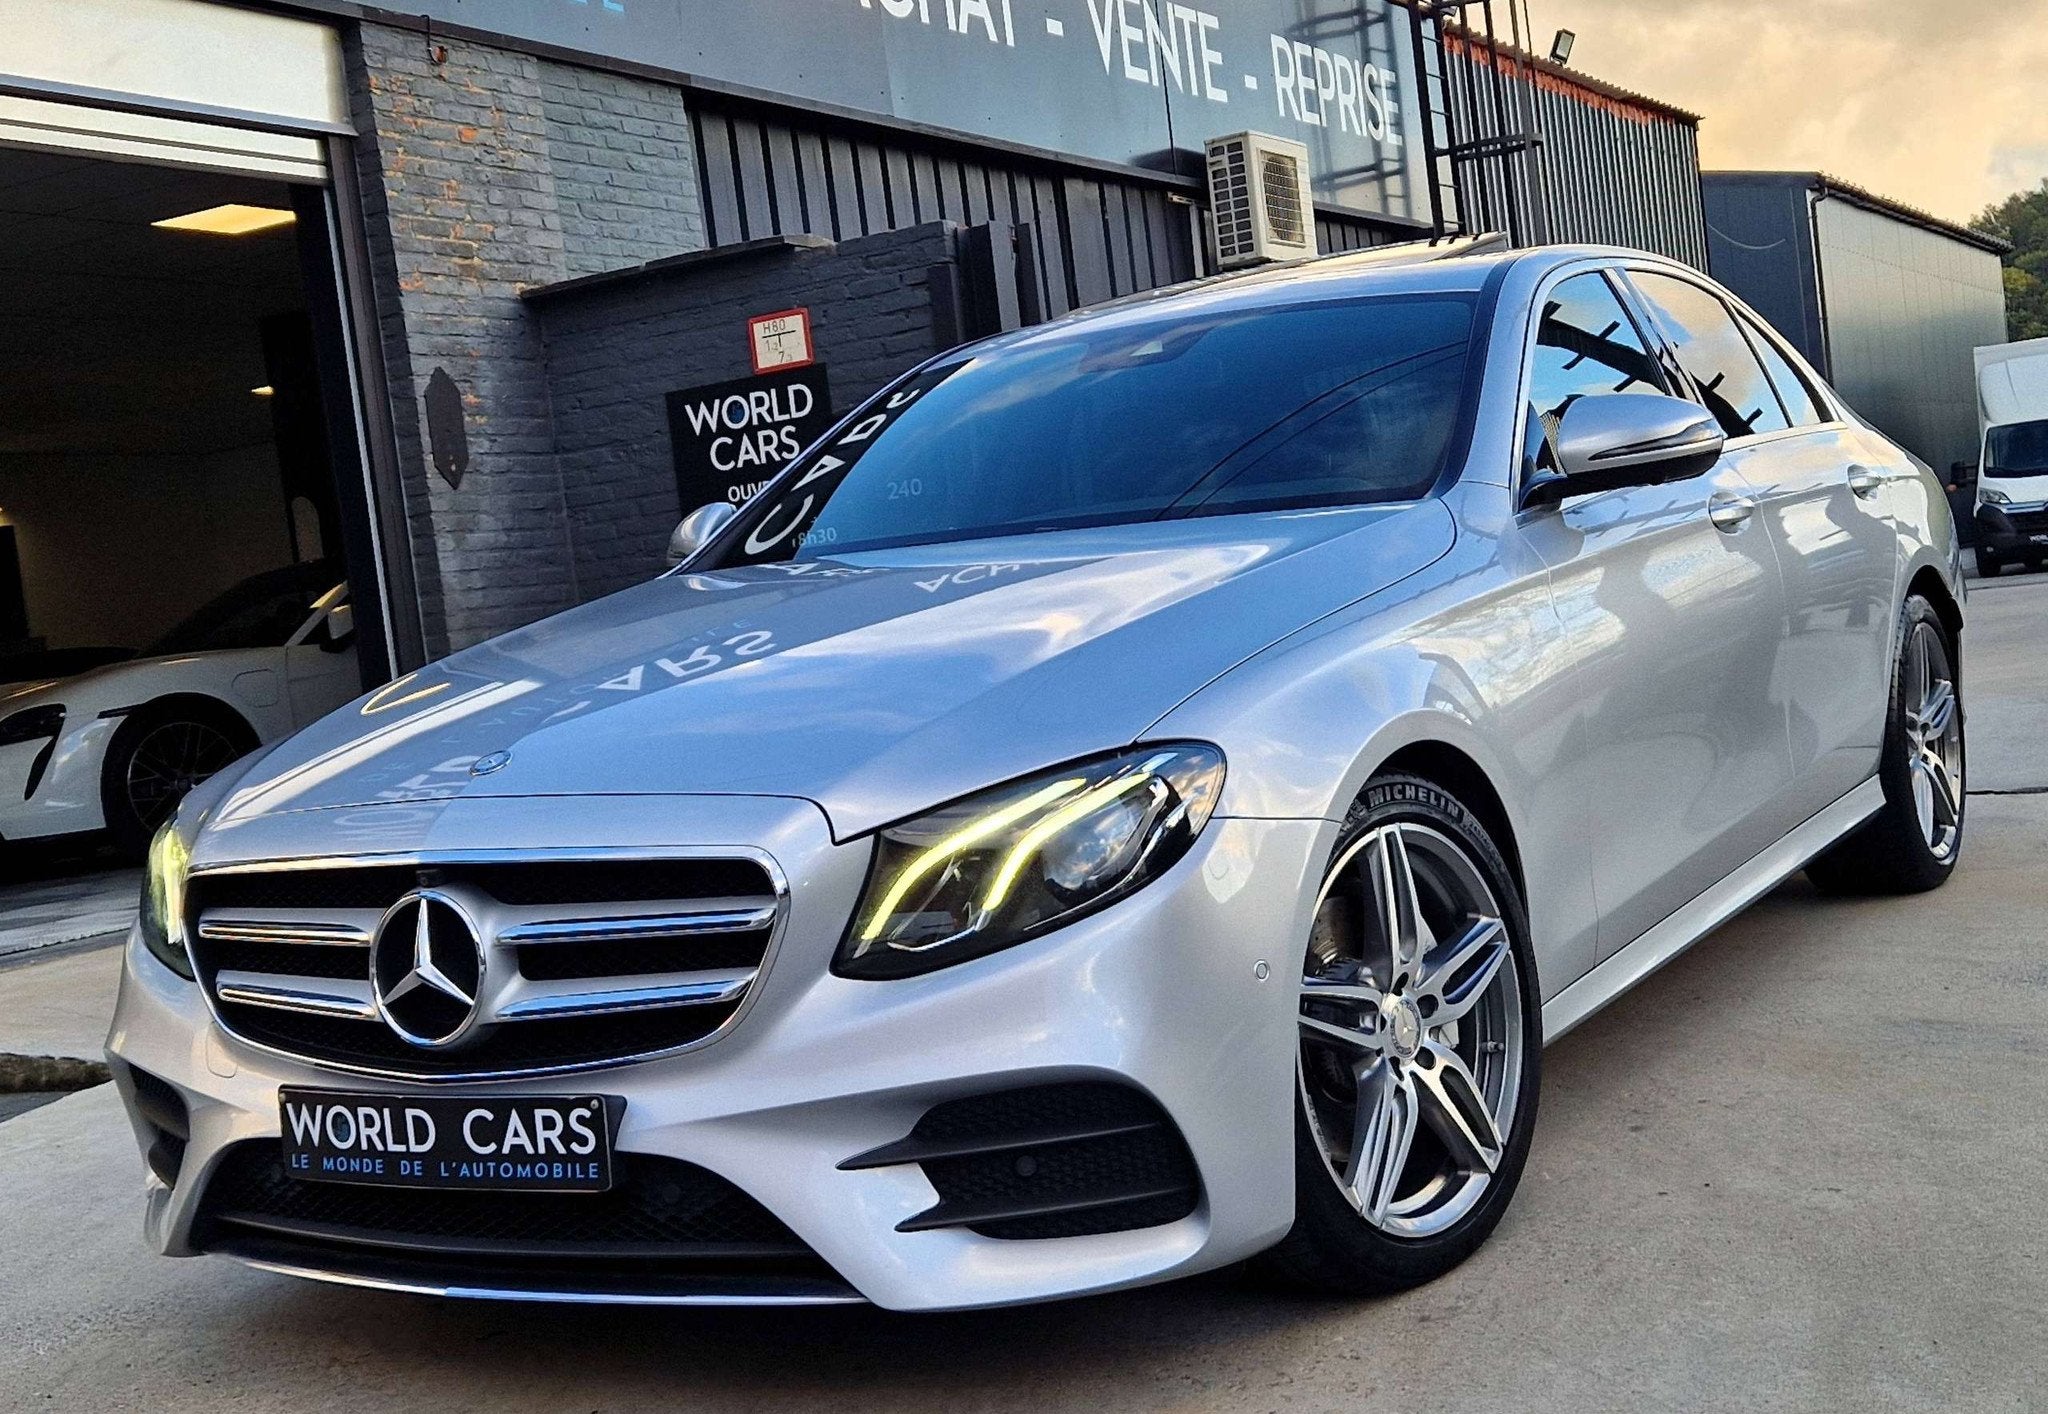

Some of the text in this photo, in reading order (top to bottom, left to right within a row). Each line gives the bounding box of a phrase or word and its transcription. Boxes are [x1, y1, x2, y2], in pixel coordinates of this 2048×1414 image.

[1087, 0, 1228, 103] VENTE
[1270, 33, 1403, 146] REPRISE
[762, 318, 787, 334] H80
[684, 383, 813, 436] WORLD
[709, 425, 800, 471] CARS
[727, 480, 772, 502] OUV
[1367, 783, 1460, 819] MICHELIN
[285, 1102, 597, 1155] WORLD CARS
[291, 1153, 599, 1179] LE MONDE DE L'AUTOMOBILE
